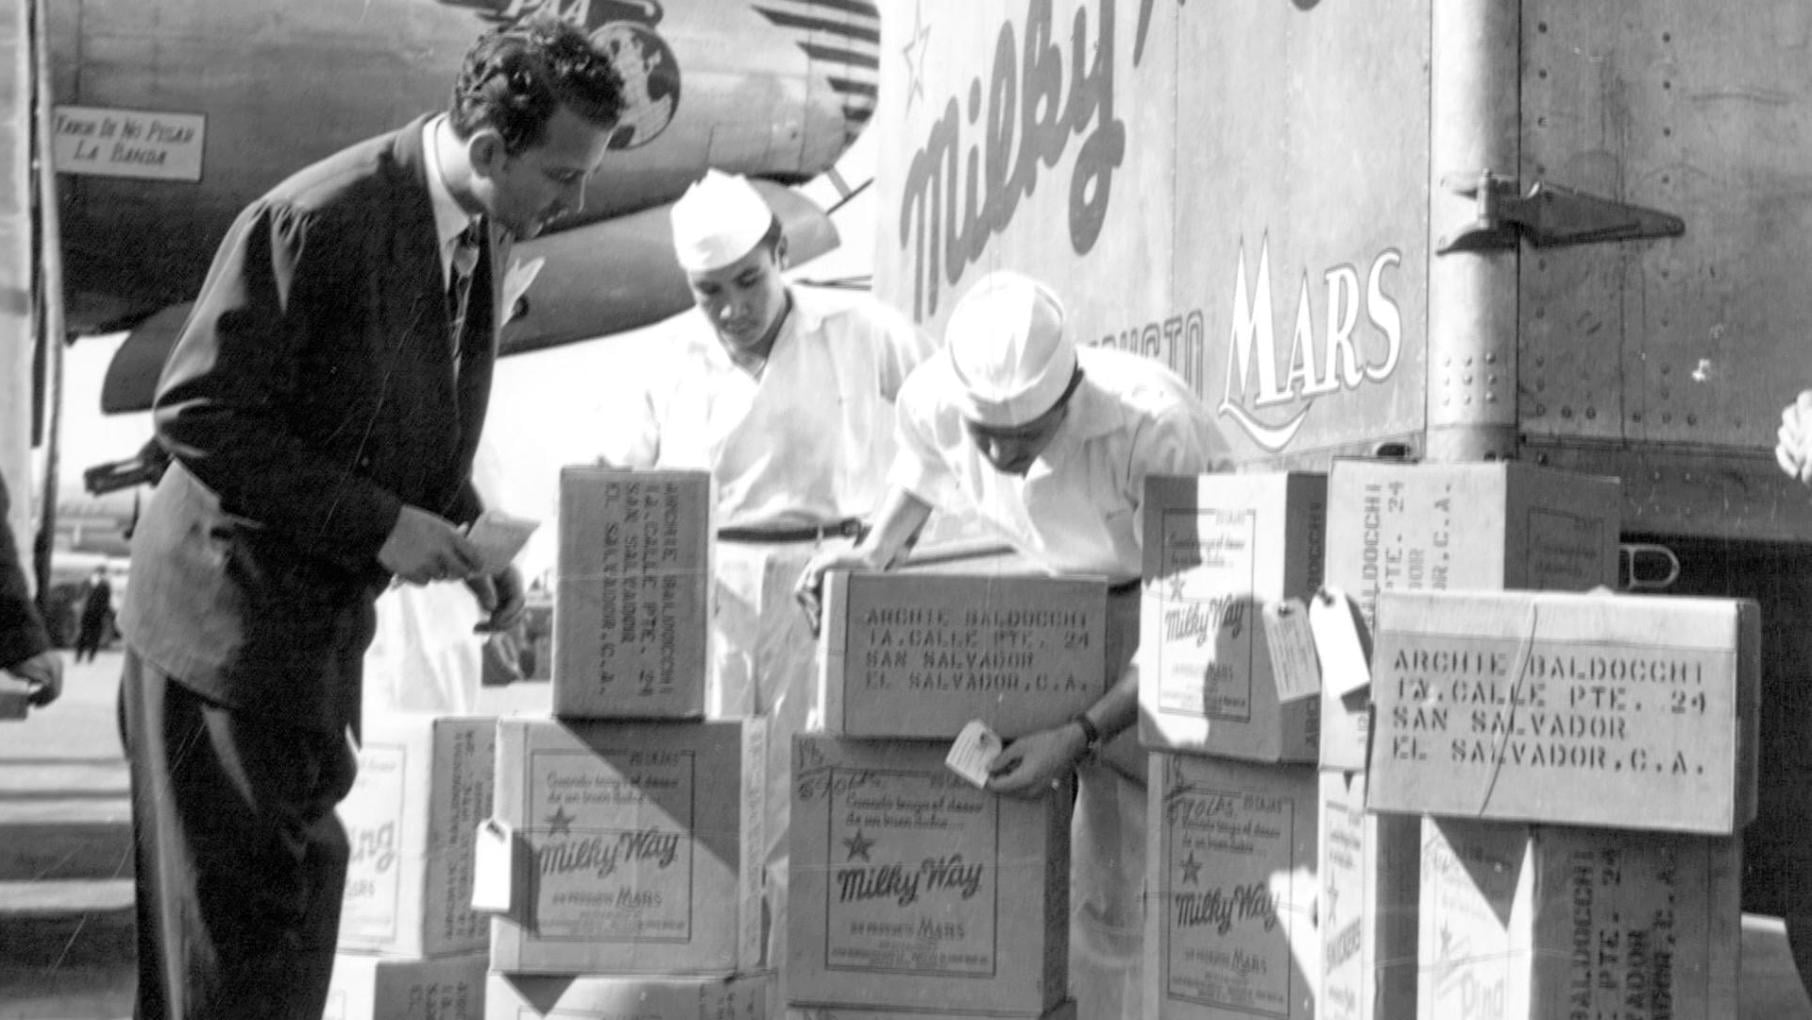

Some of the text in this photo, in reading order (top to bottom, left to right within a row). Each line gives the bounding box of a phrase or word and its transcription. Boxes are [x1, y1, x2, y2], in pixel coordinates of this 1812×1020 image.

[73, 138, 99, 160] LA
[1220, 228, 1403, 412] MARS
[1386, 480, 1405, 514] 24
[866, 608, 1087, 629] ARCHIE BALDOCCHI
[1063, 631, 1089, 650] 24
[866, 651, 1034, 670] SAN SALVADOR
[1393, 649, 1703, 685] ARCHIE BALDOCCHI
[866, 670, 891, 690] EL
[1569, 684, 1642, 712] PTE.
[1670, 690, 1706, 716] 24
[1392, 705, 1449, 732] SAN
[1471, 709, 1628, 741] SALVADOR
[1393, 734, 1428, 762] EL
[350, 819, 396, 874] ing
[540, 827, 680, 879] Milky Way
[837, 854, 983, 908] Milky Way
[1175, 882, 1280, 936] Milky Way
